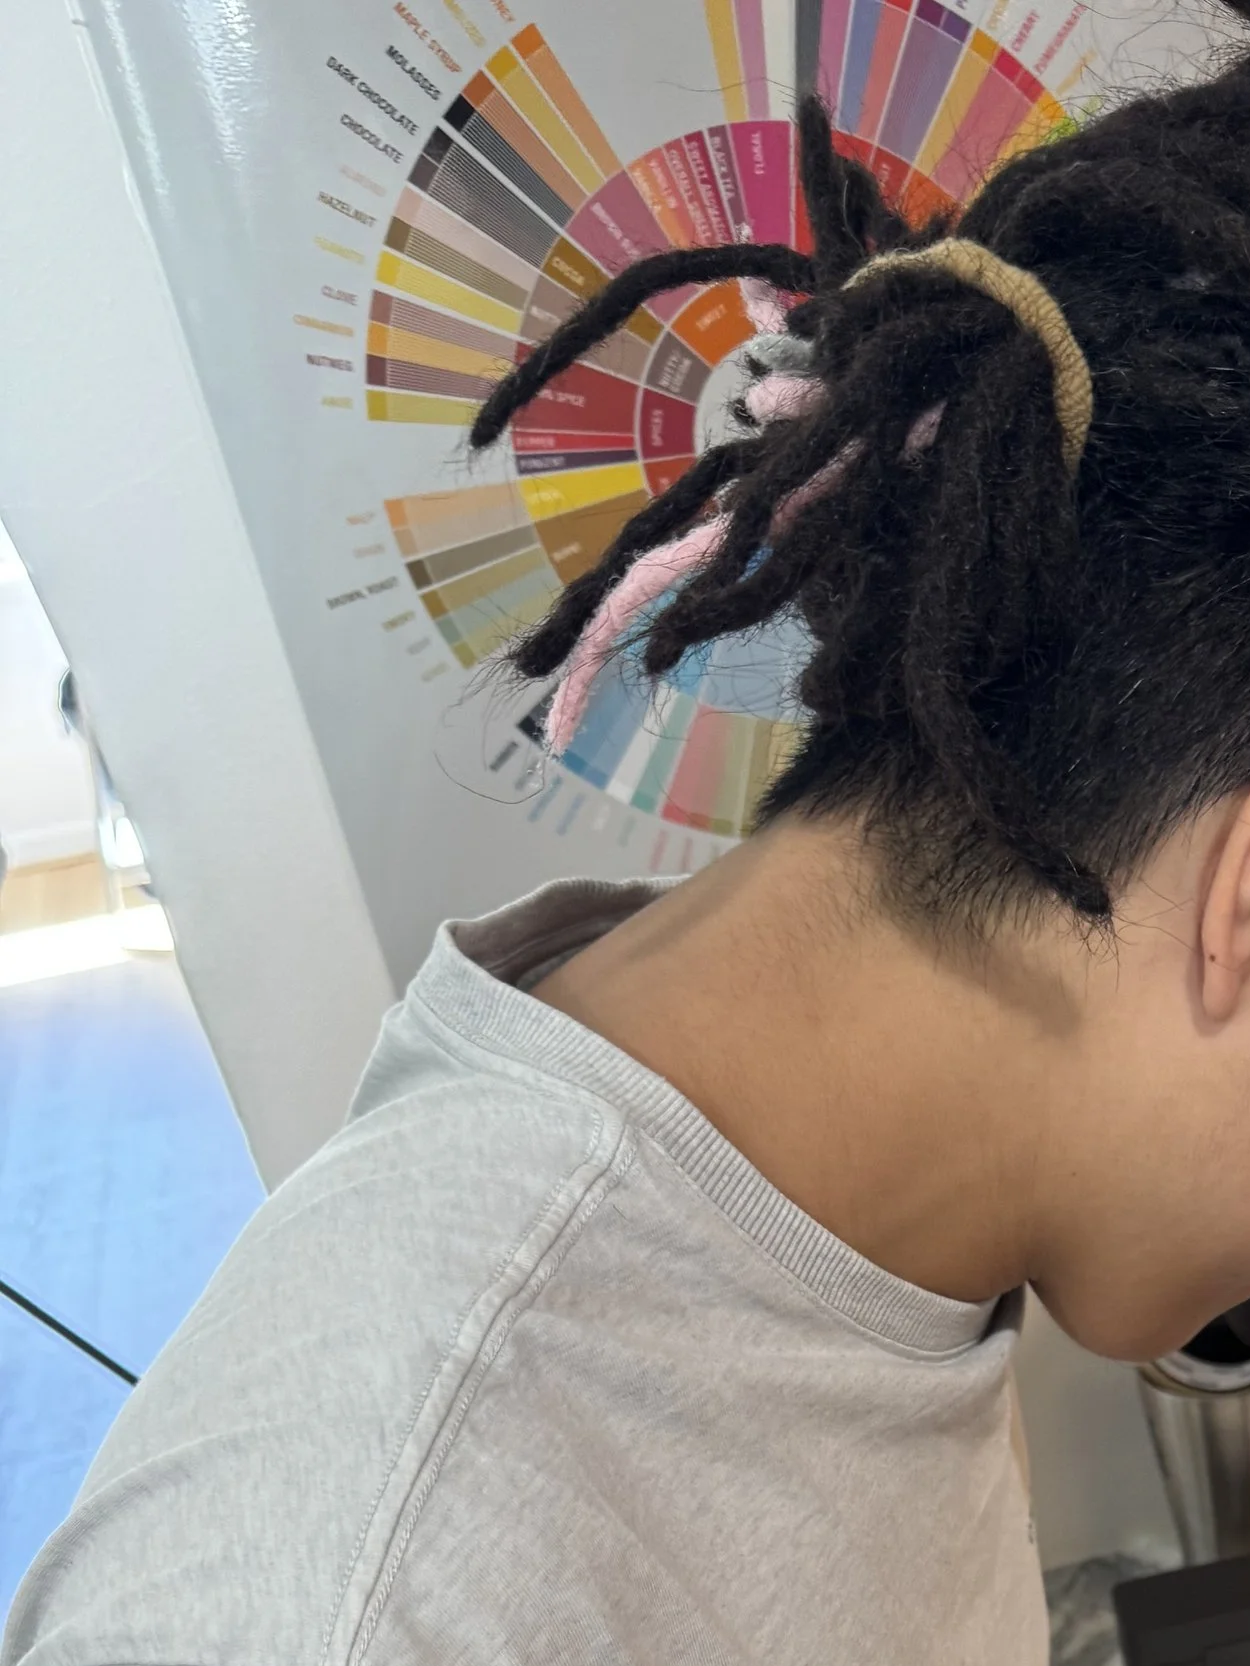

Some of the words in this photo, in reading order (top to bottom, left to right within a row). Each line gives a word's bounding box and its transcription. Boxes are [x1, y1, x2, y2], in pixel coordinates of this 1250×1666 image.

[326, 56, 359, 87] DARK
[357, 80, 420, 137] CHOCOLATE
[385, 45, 442, 101] MOLASSES
[340, 113, 405, 165] CHOCOLATE
[751, 130, 766, 175] FLORAL
[711, 136, 728, 180] BLACK
[723, 176, 737, 201] TEA
